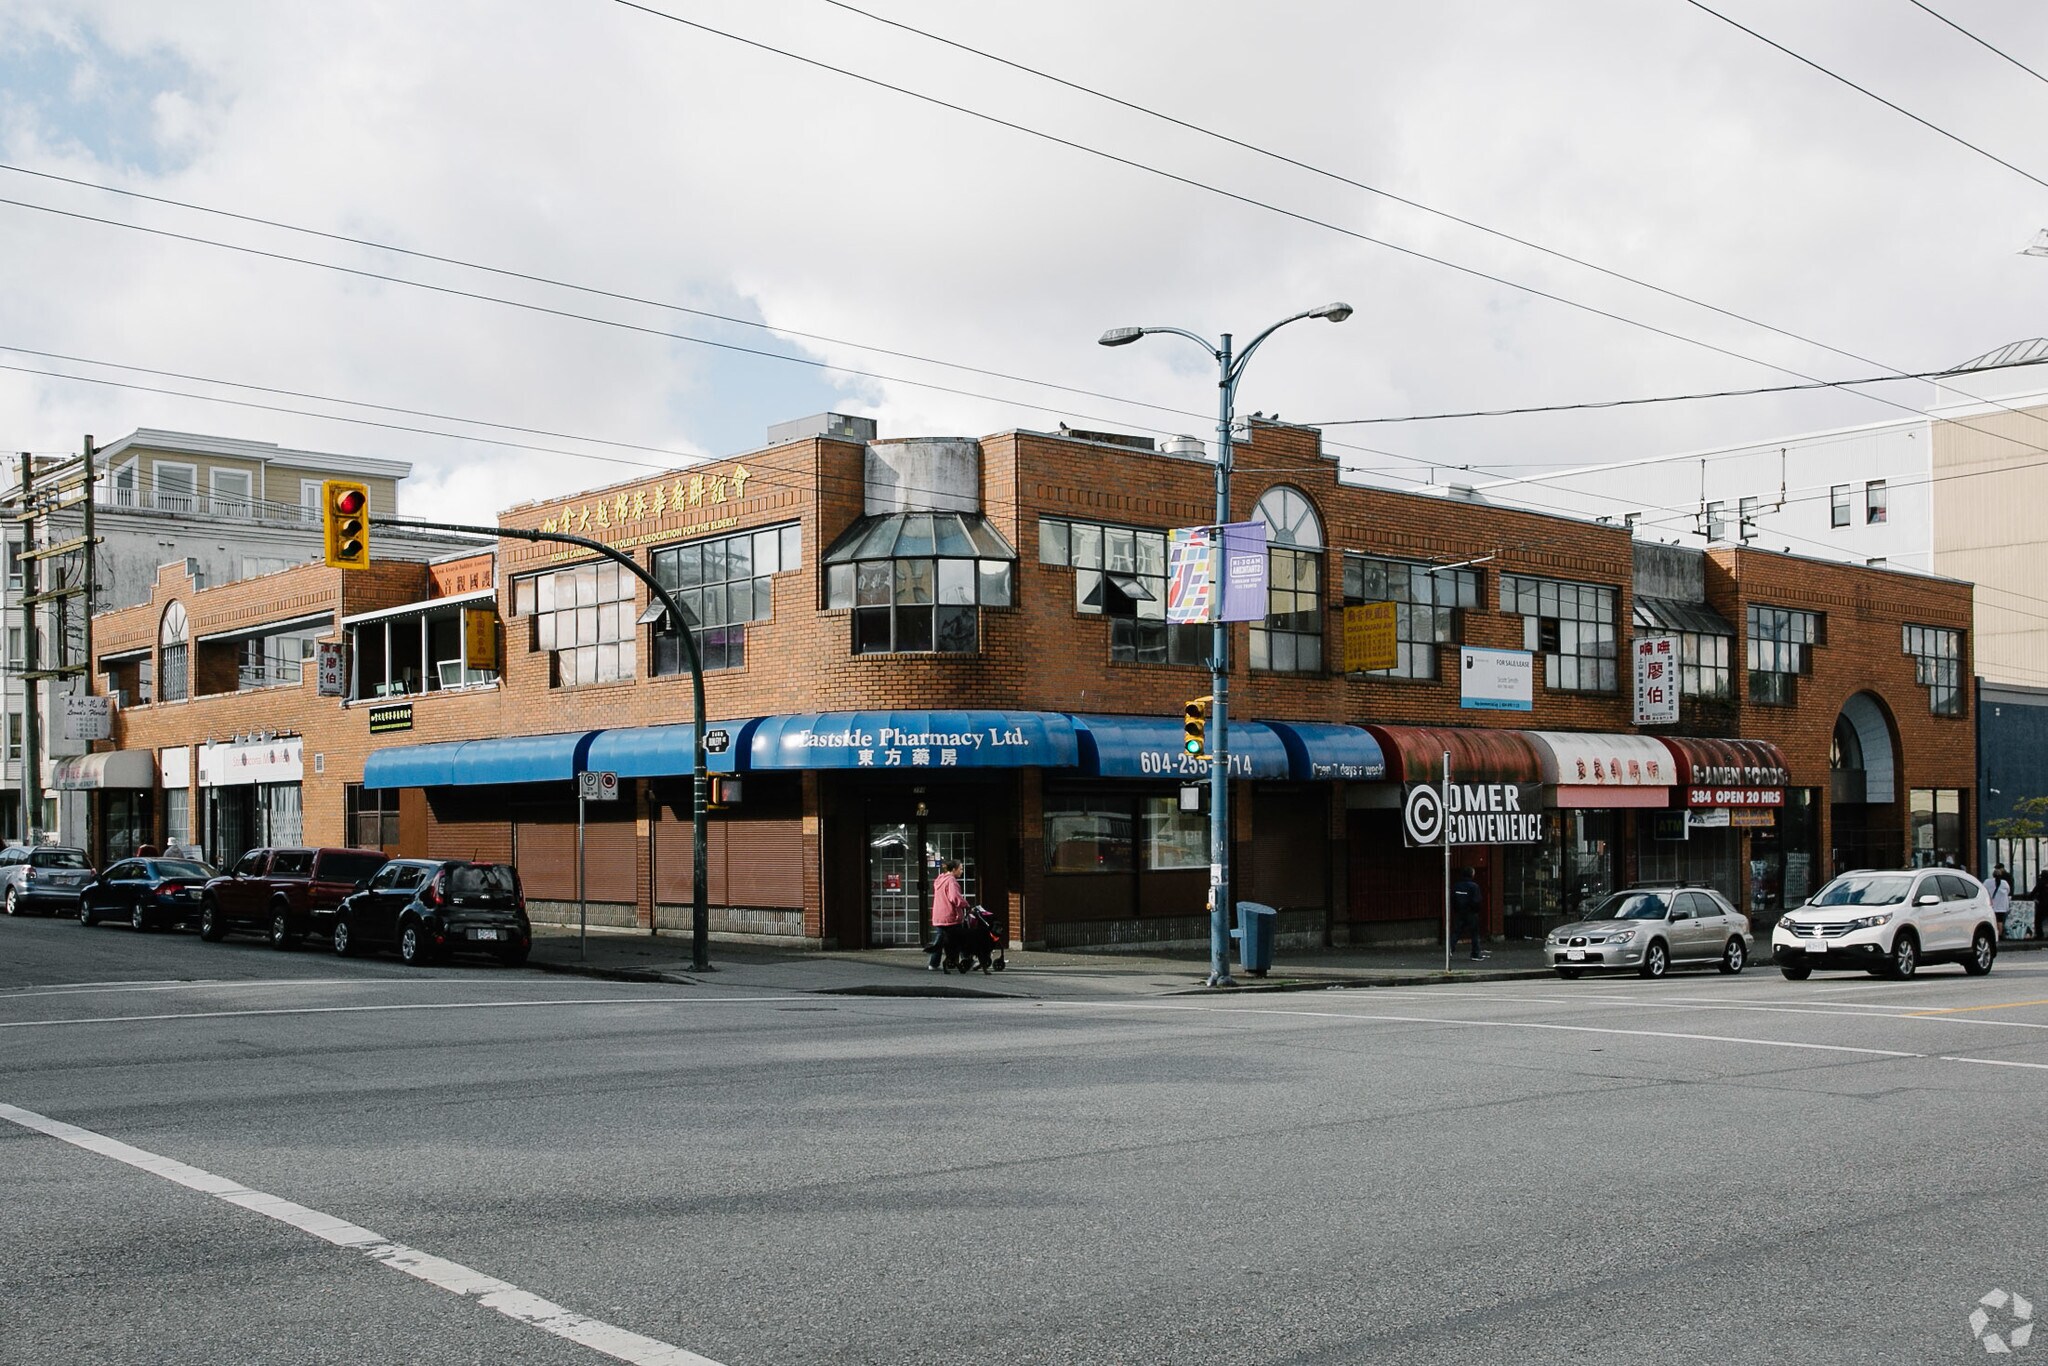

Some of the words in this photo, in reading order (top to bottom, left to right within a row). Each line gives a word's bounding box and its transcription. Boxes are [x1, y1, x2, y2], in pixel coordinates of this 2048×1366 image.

[551, 550, 569, 562] ASIAN
[640, 526, 682, 545] ASSOCIATION
[683, 524, 696, 536] FOR
[696, 522, 710, 532] THE
[711, 516, 738, 530] ELDERLY
[1496, 658, 1505, 666] FOR
[799, 728, 873, 748] Eastside
[879, 727, 984, 750] Pharmacy
[989, 727, 1029, 746] Ltd.
[858, 747, 958, 767] 東方藥房
[1333, 762, 1338, 776] 7
[1691, 789, 1712, 803] 384
[1715, 790, 1745, 804] OPEN
[1746, 790, 1760, 804] 20
[1761, 790, 1781, 804] HRS
[1448, 813, 1543, 843] CONVENIENCE
